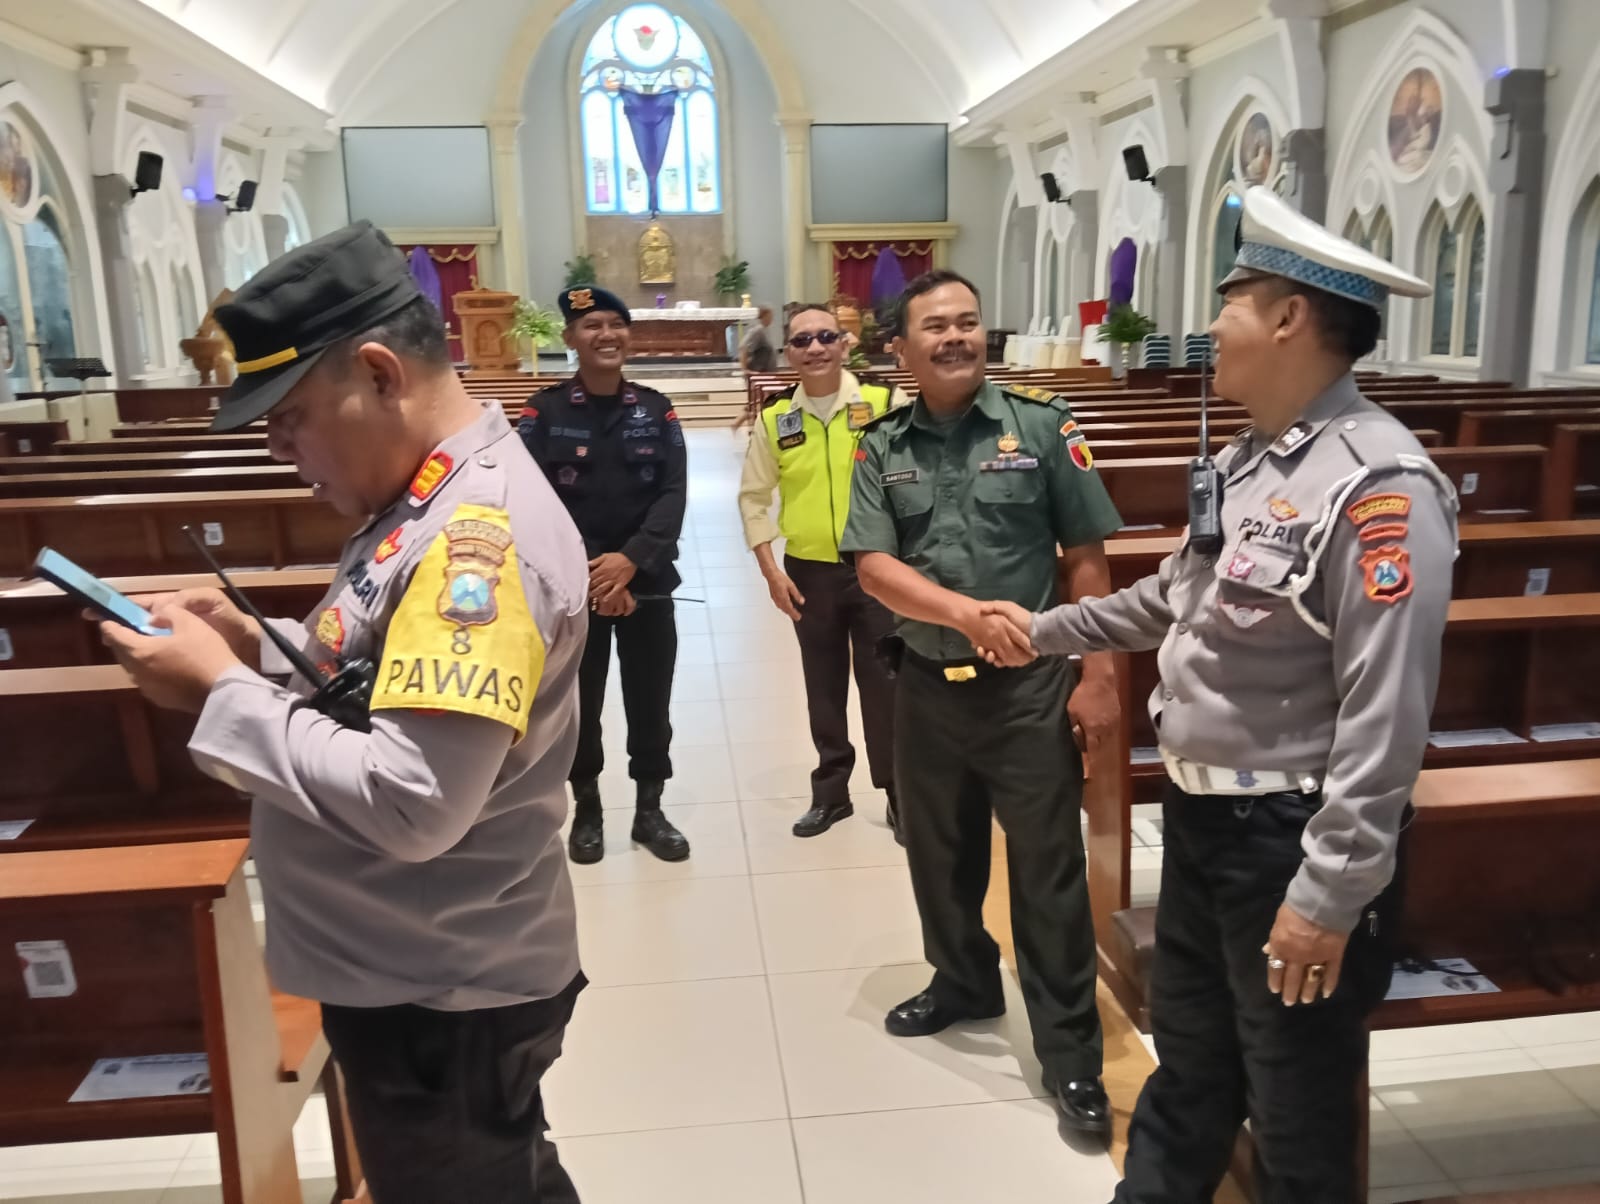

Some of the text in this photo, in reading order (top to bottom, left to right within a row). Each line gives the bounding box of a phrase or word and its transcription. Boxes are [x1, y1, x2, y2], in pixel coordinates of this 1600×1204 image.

[1238, 517, 1294, 544] POLRI
[451, 627, 472, 655] 8
[384, 657, 523, 712] PAWAS
